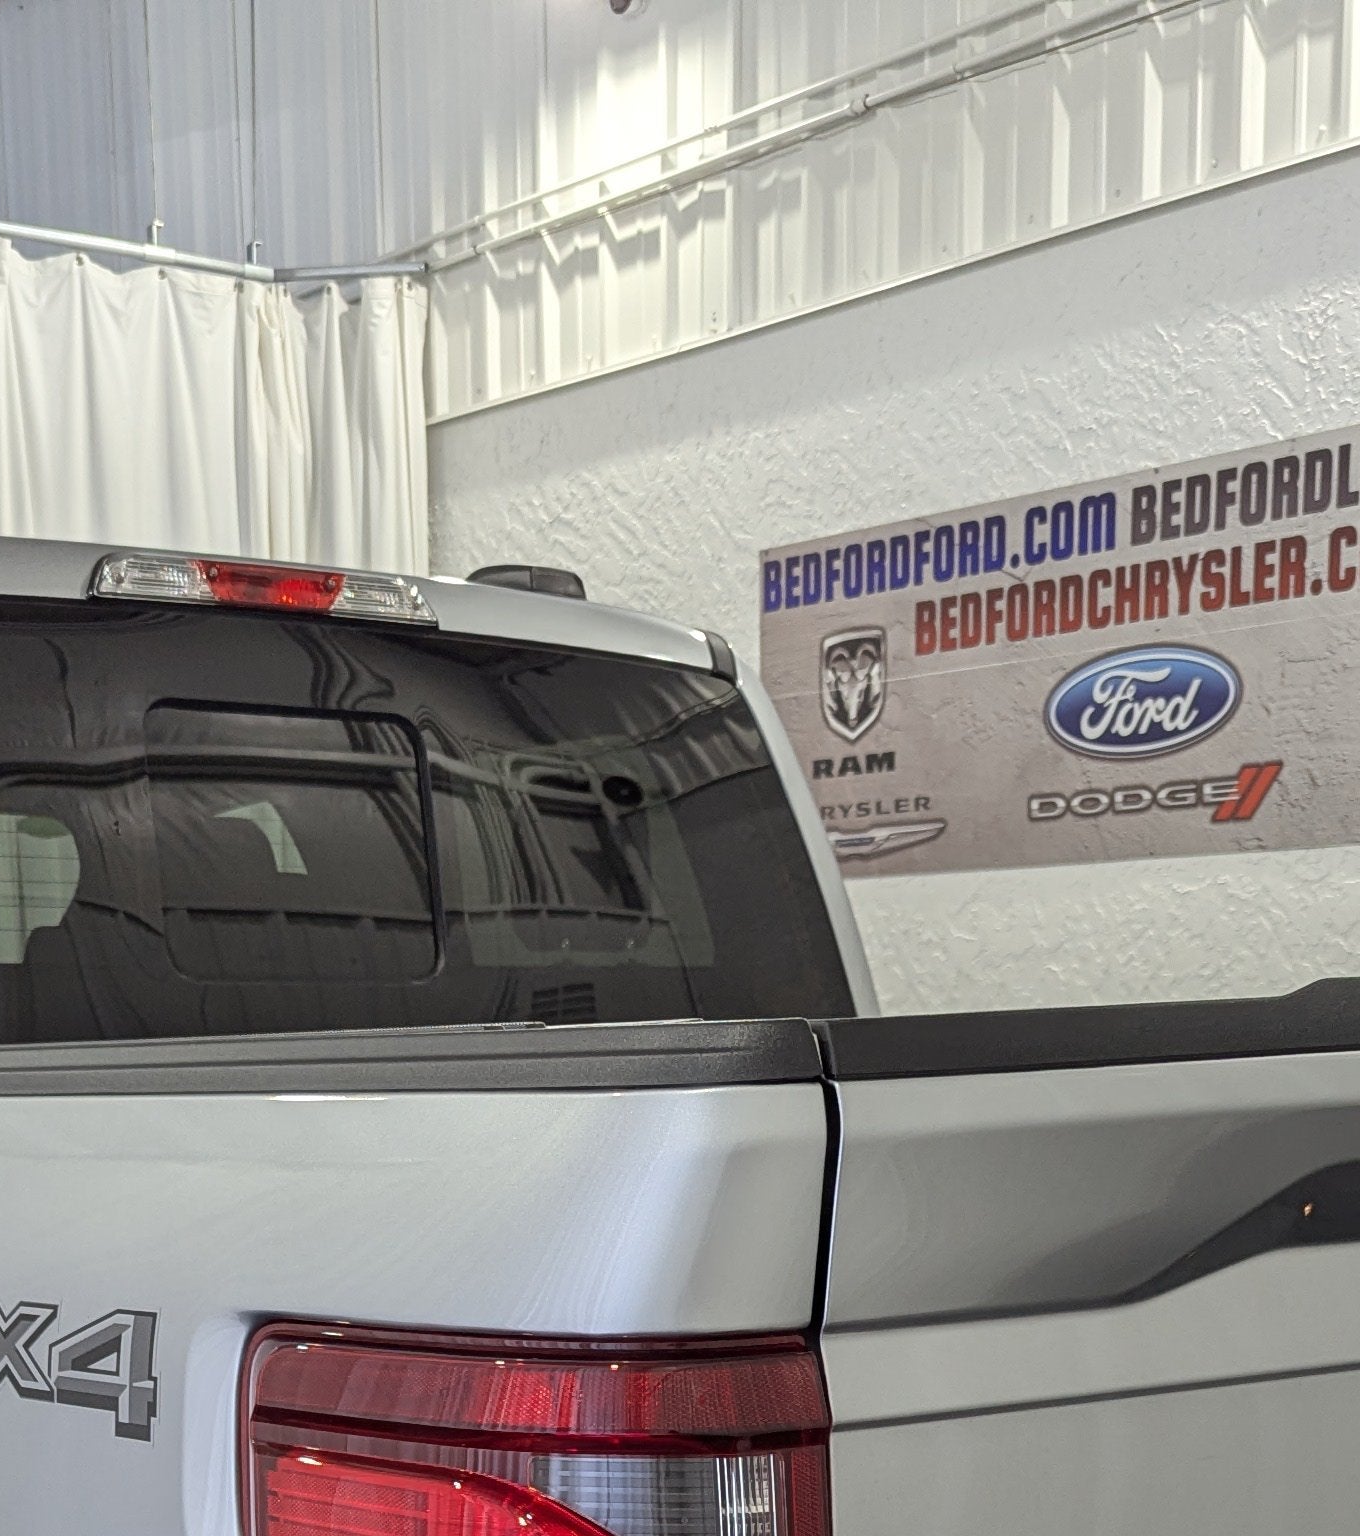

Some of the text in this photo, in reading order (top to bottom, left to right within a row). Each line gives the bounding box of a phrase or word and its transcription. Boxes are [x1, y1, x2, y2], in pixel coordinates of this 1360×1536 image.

[763, 490, 1117, 614] BEDFORDFORD.COM
[1079, 665, 1203, 740] Ford
[812, 751, 897, 780] RAM
[820, 795, 932, 821] RYSLER
[1027, 775, 1240, 822] DODGE
